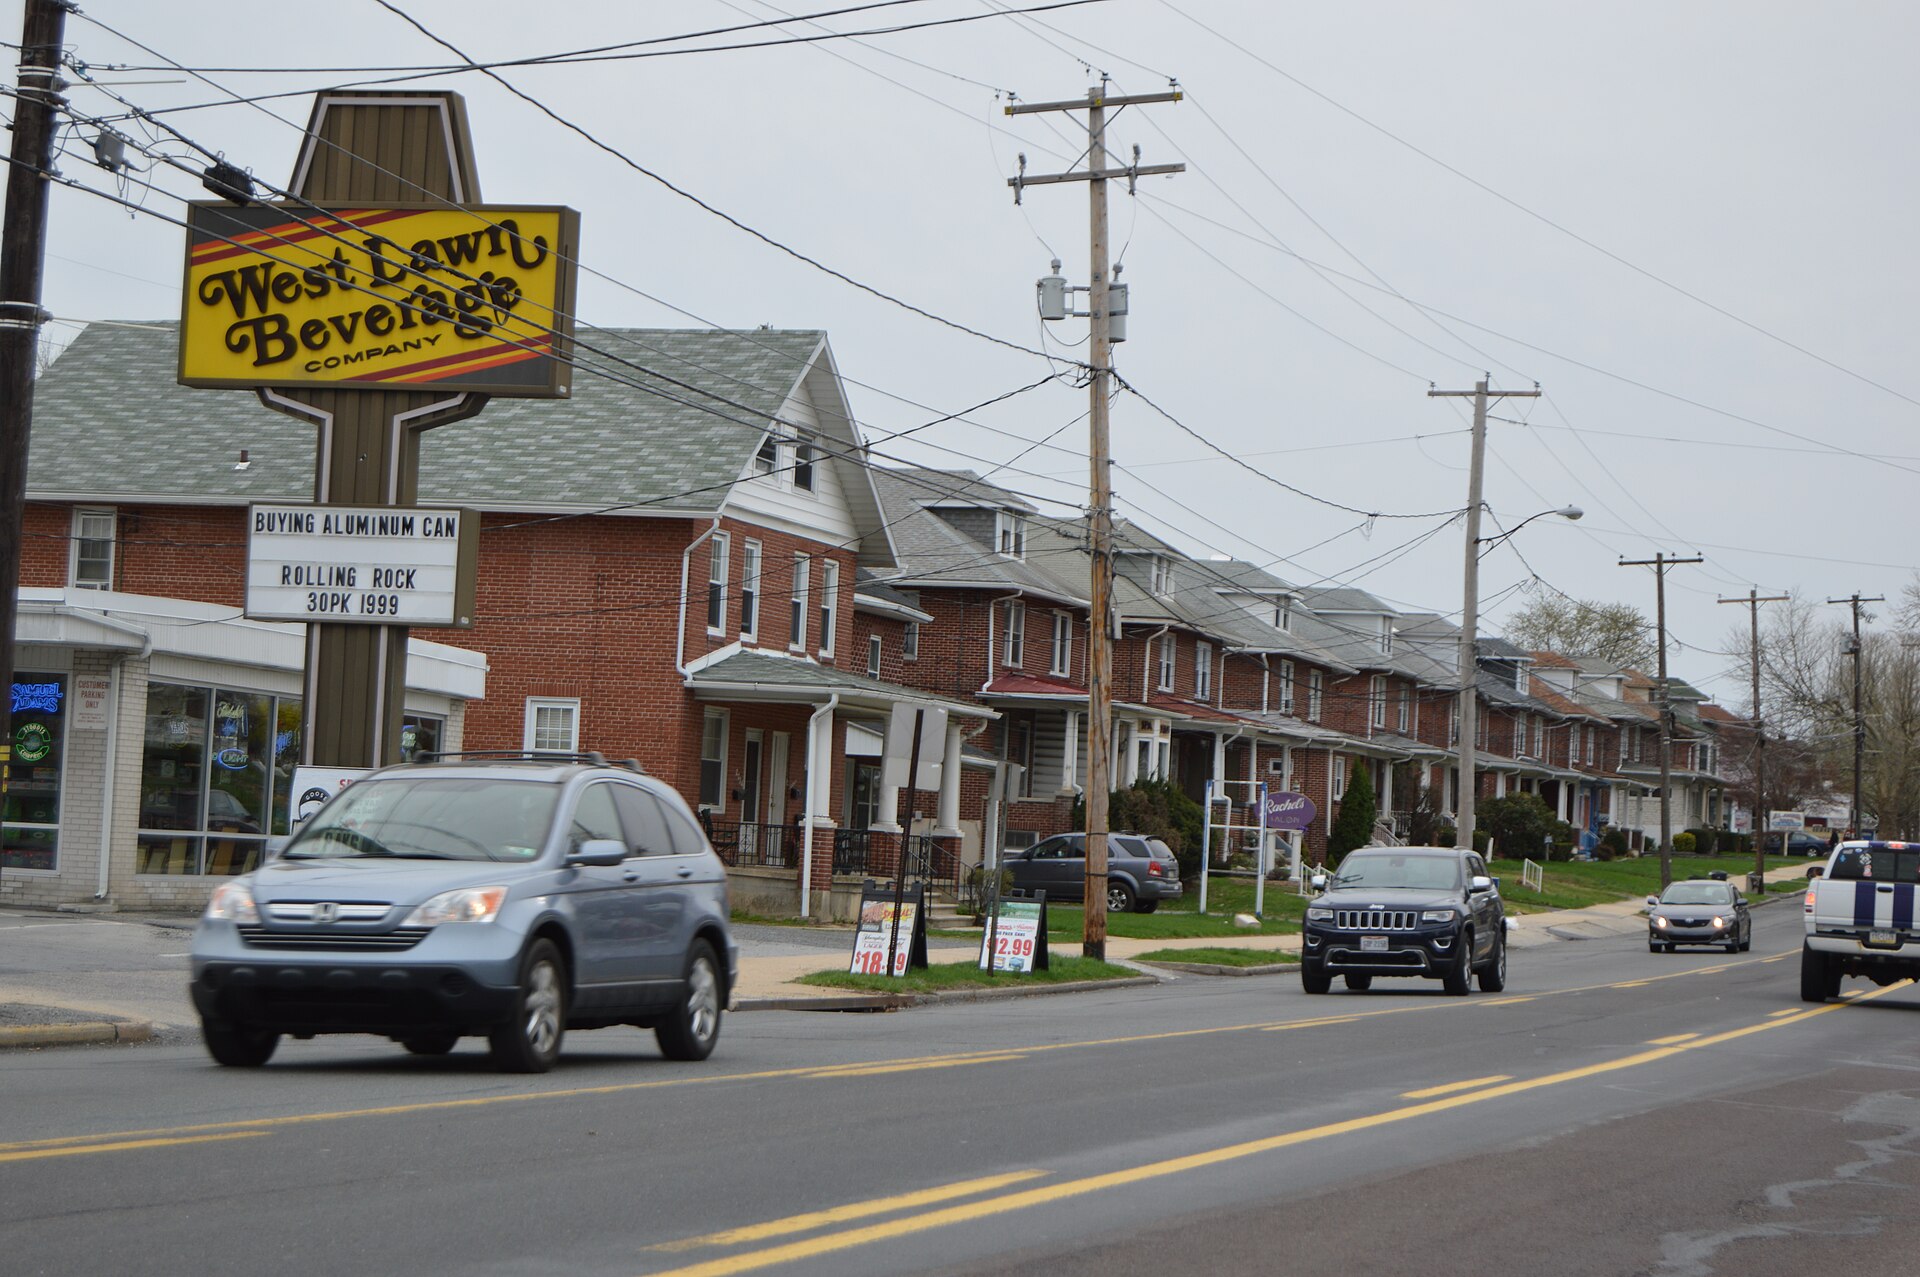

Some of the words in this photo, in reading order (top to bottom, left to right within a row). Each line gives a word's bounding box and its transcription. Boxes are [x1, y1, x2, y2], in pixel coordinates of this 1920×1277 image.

[199, 246, 356, 320] West
[361, 218, 548, 289] Lawn
[224, 270, 523, 368] Beverage
[303, 333, 442, 373] COMPANY
[255, 512, 315, 534] BUYING
[322, 514, 415, 537] ALUMINUM
[422, 516, 457, 538] CAN
[281, 565, 357, 587] ROLLING
[372, 567, 417, 589] ROCK
[307, 592, 352, 613] 30PK
[360, 593, 399, 615] 1999
[11, 682, 63, 698] SAMUEL
[78, 680, 111, 690] CUSTOMER
[80, 690, 105, 699] PARKING
[11, 697, 58, 713] ADAMS
[85, 700, 99, 709] ONLY
[1266, 797, 1305, 814] Rachel's
